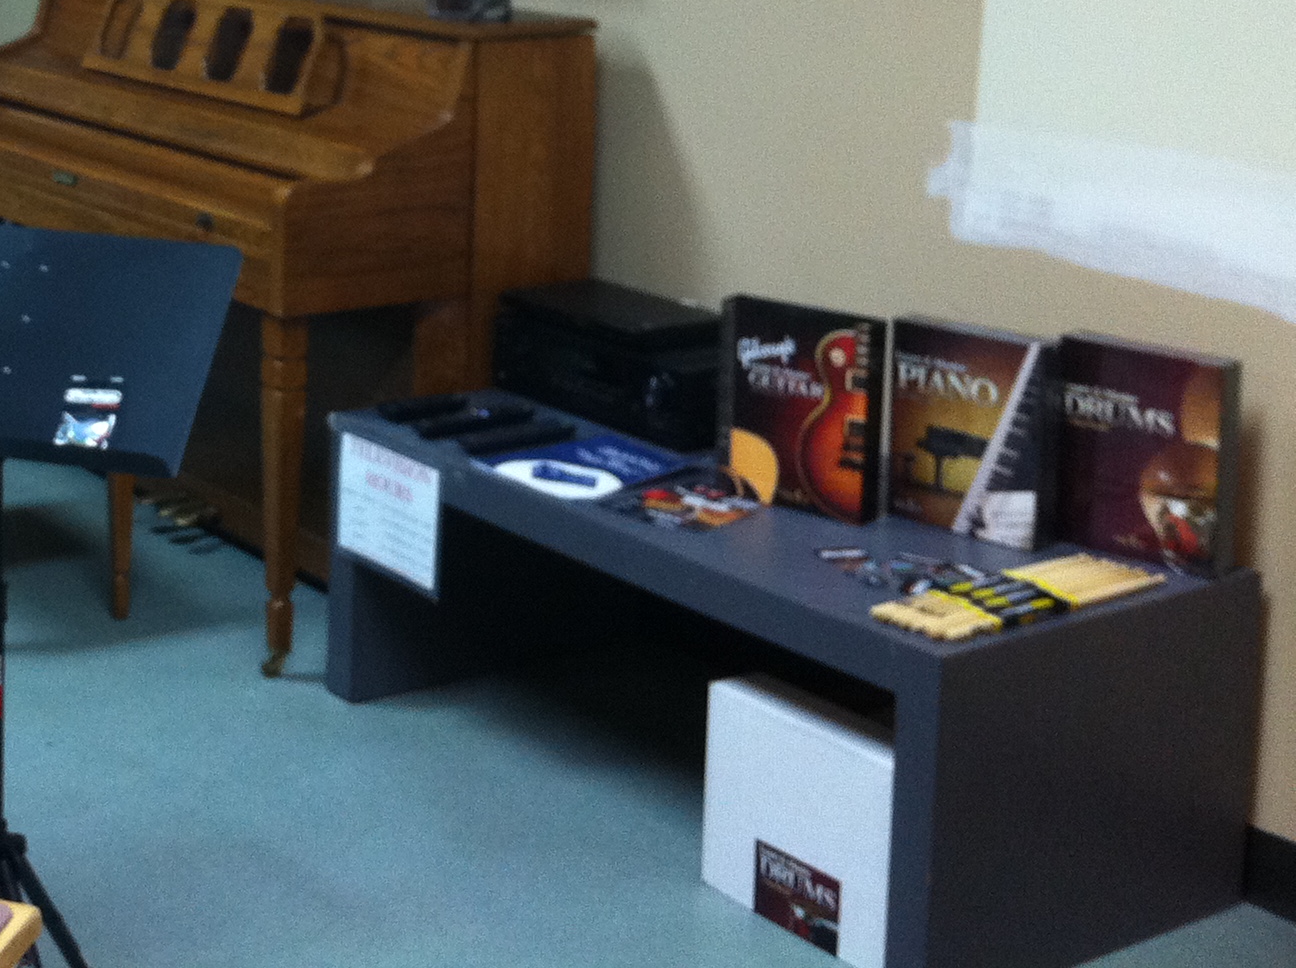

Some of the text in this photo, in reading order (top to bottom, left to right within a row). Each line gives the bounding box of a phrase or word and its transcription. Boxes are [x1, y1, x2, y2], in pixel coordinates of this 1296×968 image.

[898, 362, 999, 408] PIANO
[1065, 392, 1176, 436] DRUMS
[760, 855, 837, 912] DRUMS
